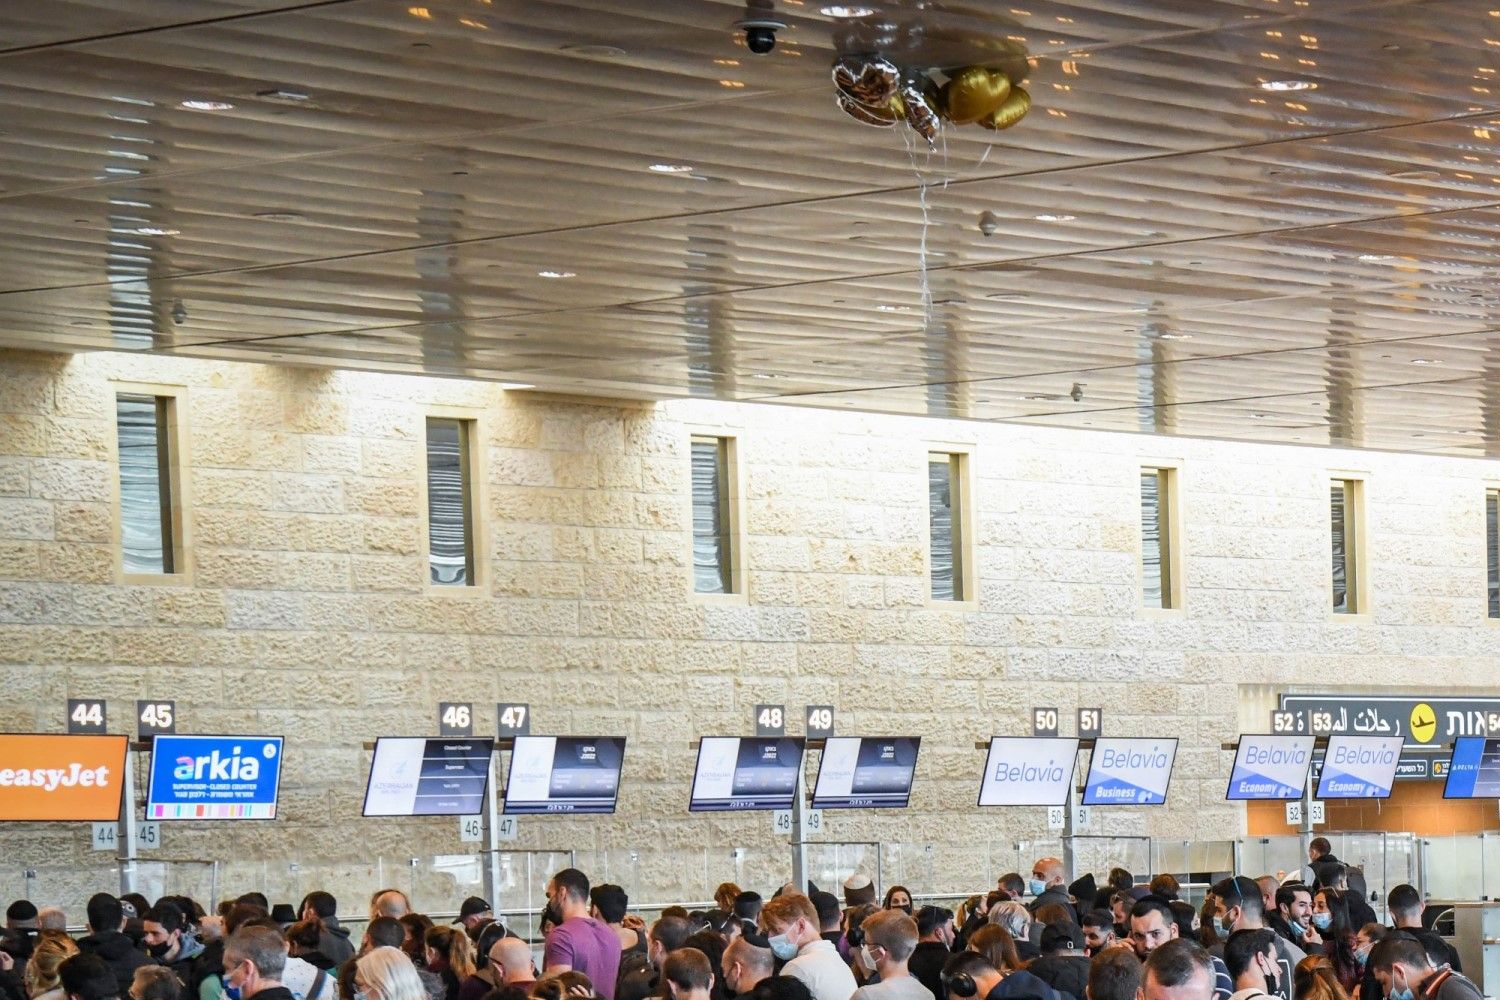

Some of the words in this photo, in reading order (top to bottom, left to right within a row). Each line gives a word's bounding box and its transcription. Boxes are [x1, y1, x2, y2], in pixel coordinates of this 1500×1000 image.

[71, 703, 104, 727] 44
[140, 704, 173, 728] 45
[442, 705, 470, 728] 46
[500, 706, 526, 728] 47
[758, 708, 783, 728] 48
[808, 709, 832, 730] 49
[1035, 710, 1057, 730] 50
[1080, 711, 1099, 731] 51
[1273, 713, 1294, 732] 52
[1313, 713, 1332, 732] 53
[173, 745, 260, 781] arkia
[1101, 746, 1168, 769] Belavia
[1245, 742, 1306, 765] Belavia
[1335, 742, 1395, 765] Belavia
[0, 763, 110, 792] easyJet
[994, 759, 1064, 783] Belavia
[1396, 764, 1416, 774] השערי
[1095, 786, 1136, 799] Business
[1239, 781, 1278, 796] Economy
[1327, 780, 1366, 796] Economy
[777, 814, 789, 829] 48
[807, 813, 819, 828] 49
[1051, 810, 1061, 824] 50
[1079, 810, 1087, 824] 51
[1289, 807, 1299, 820] 52
[1312, 806, 1322, 820] 53
[98, 828, 114, 843] 44
[139, 826, 155, 843] 45
[465, 821, 479, 836] 46
[500, 819, 513, 834] 47
